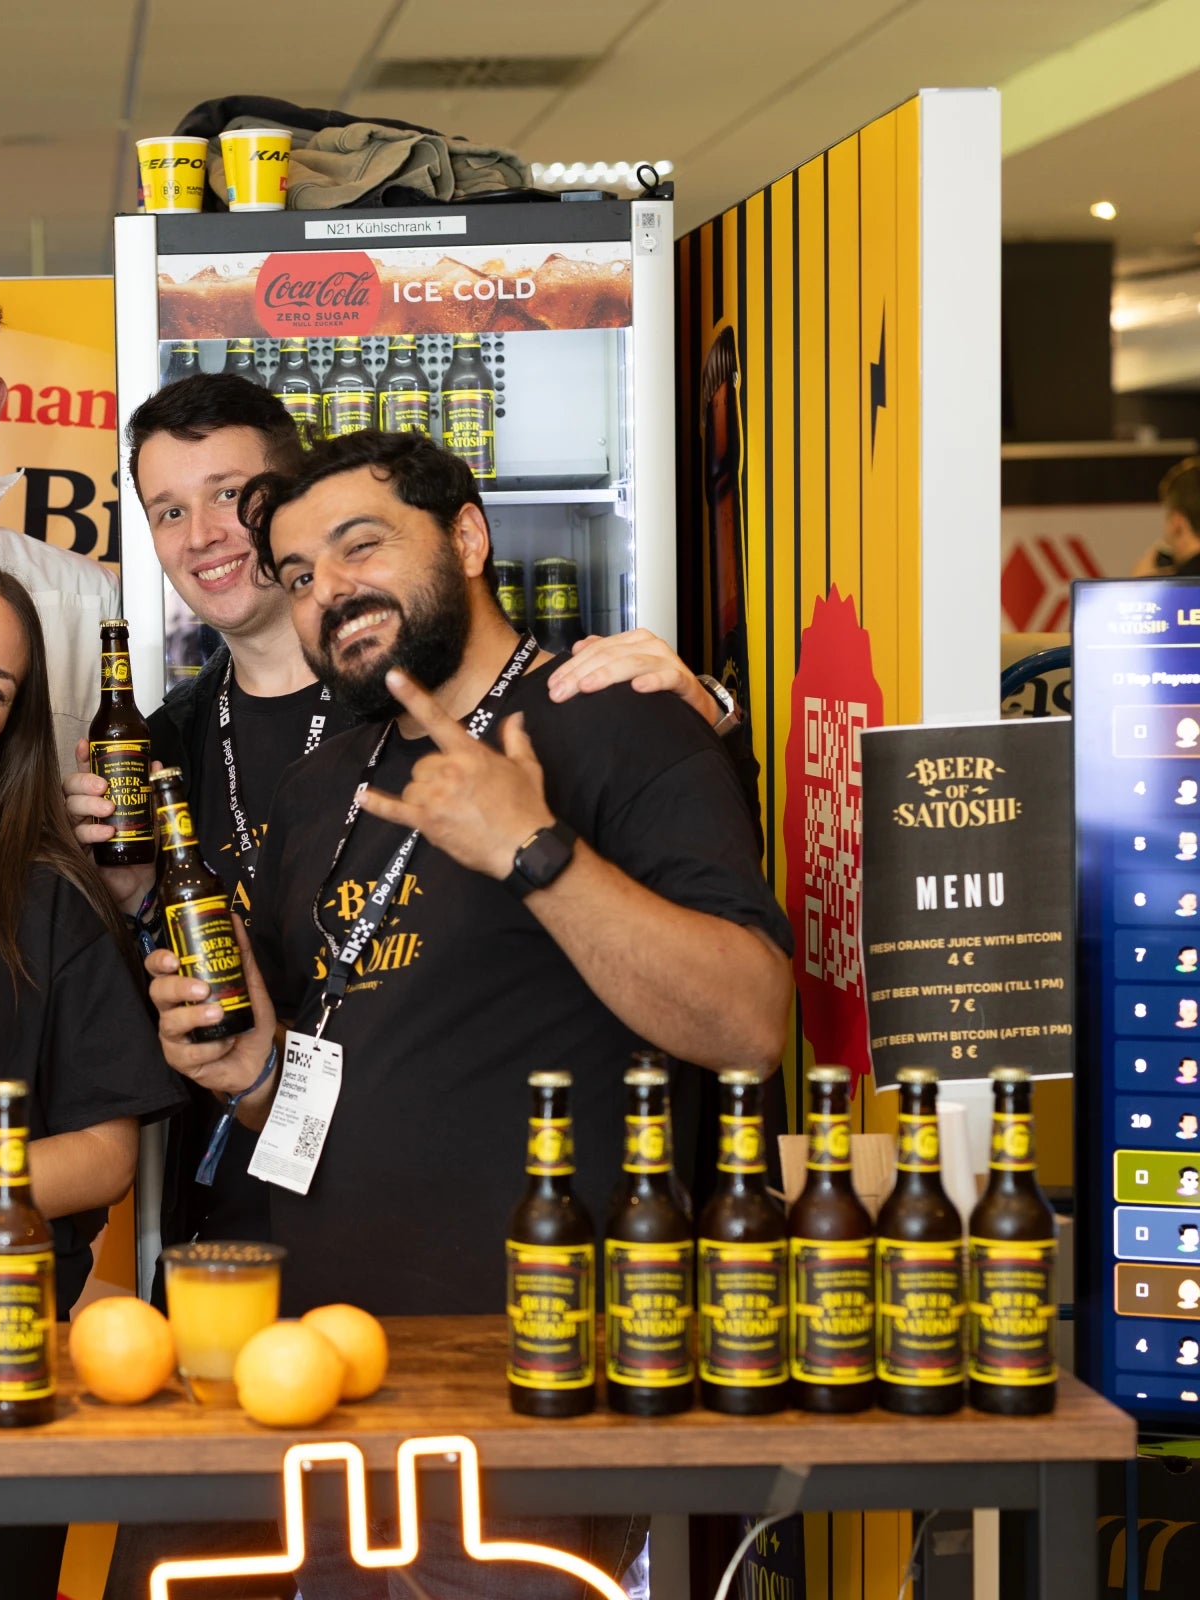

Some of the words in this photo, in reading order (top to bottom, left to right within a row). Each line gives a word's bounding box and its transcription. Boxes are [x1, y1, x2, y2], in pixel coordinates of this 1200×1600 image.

[326, 223, 351, 235] N21
[356, 220, 432, 234] Kühlschrank
[436, 220, 443, 231] 1
[264, 271, 376, 309] Coca-Cola
[392, 281, 443, 303] ICE
[453, 279, 537, 302] COLD
[276, 312, 311, 322] ZERO
[316, 311, 360, 321] SUGAR
[1177, 608, 1200, 626] LE
[490, 679, 508, 698] Die
[505, 660, 522, 682] App
[224, 765, 237, 794] neues
[914, 756, 996, 787] BEER
[110, 776, 140, 788] BEER
[945, 784, 970, 799] OF
[233, 810, 247, 833] App
[898, 797, 1017, 828] SATOSHI
[240, 832, 252, 851] Die
[372, 884, 391, 905] Die
[385, 856, 404, 883] App
[399, 838, 414, 856] für
[915, 872, 1005, 911] MENU
[869, 941, 897, 954] FRESH
[899, 938, 945, 951] ORANGE
[947, 936, 981, 948] JUICE
[983, 934, 1014, 946] WITH
[1016, 932, 1063, 945] BITCOIN
[947, 953, 959, 966] 4
[963, 952, 975, 965] €
[1134, 947, 1147, 962] 7
[892, 986, 919, 998] BEER
[921, 984, 952, 996] WITH
[954, 982, 1003, 995] BITCOIN
[1004, 980, 1032, 994] (TILL
[1034, 980, 1040, 990] 1
[1041, 978, 1064, 990] PM)
[949, 999, 960, 1013] 7
[964, 998, 976, 1012] €
[889, 1034, 915, 1046] BEER
[916, 1031, 948, 1043] WITH
[950, 1028, 998, 1041] BITCOIN
[1000, 1026, 1040, 1039] (AFTER
[1042, 1025, 1048, 1035] 1
[1050, 1024, 1073, 1036] PM)
[951, 1046, 963, 1059] 8
[966, 1045, 978, 1059] €
[1130, 1113, 1152, 1129] 10
